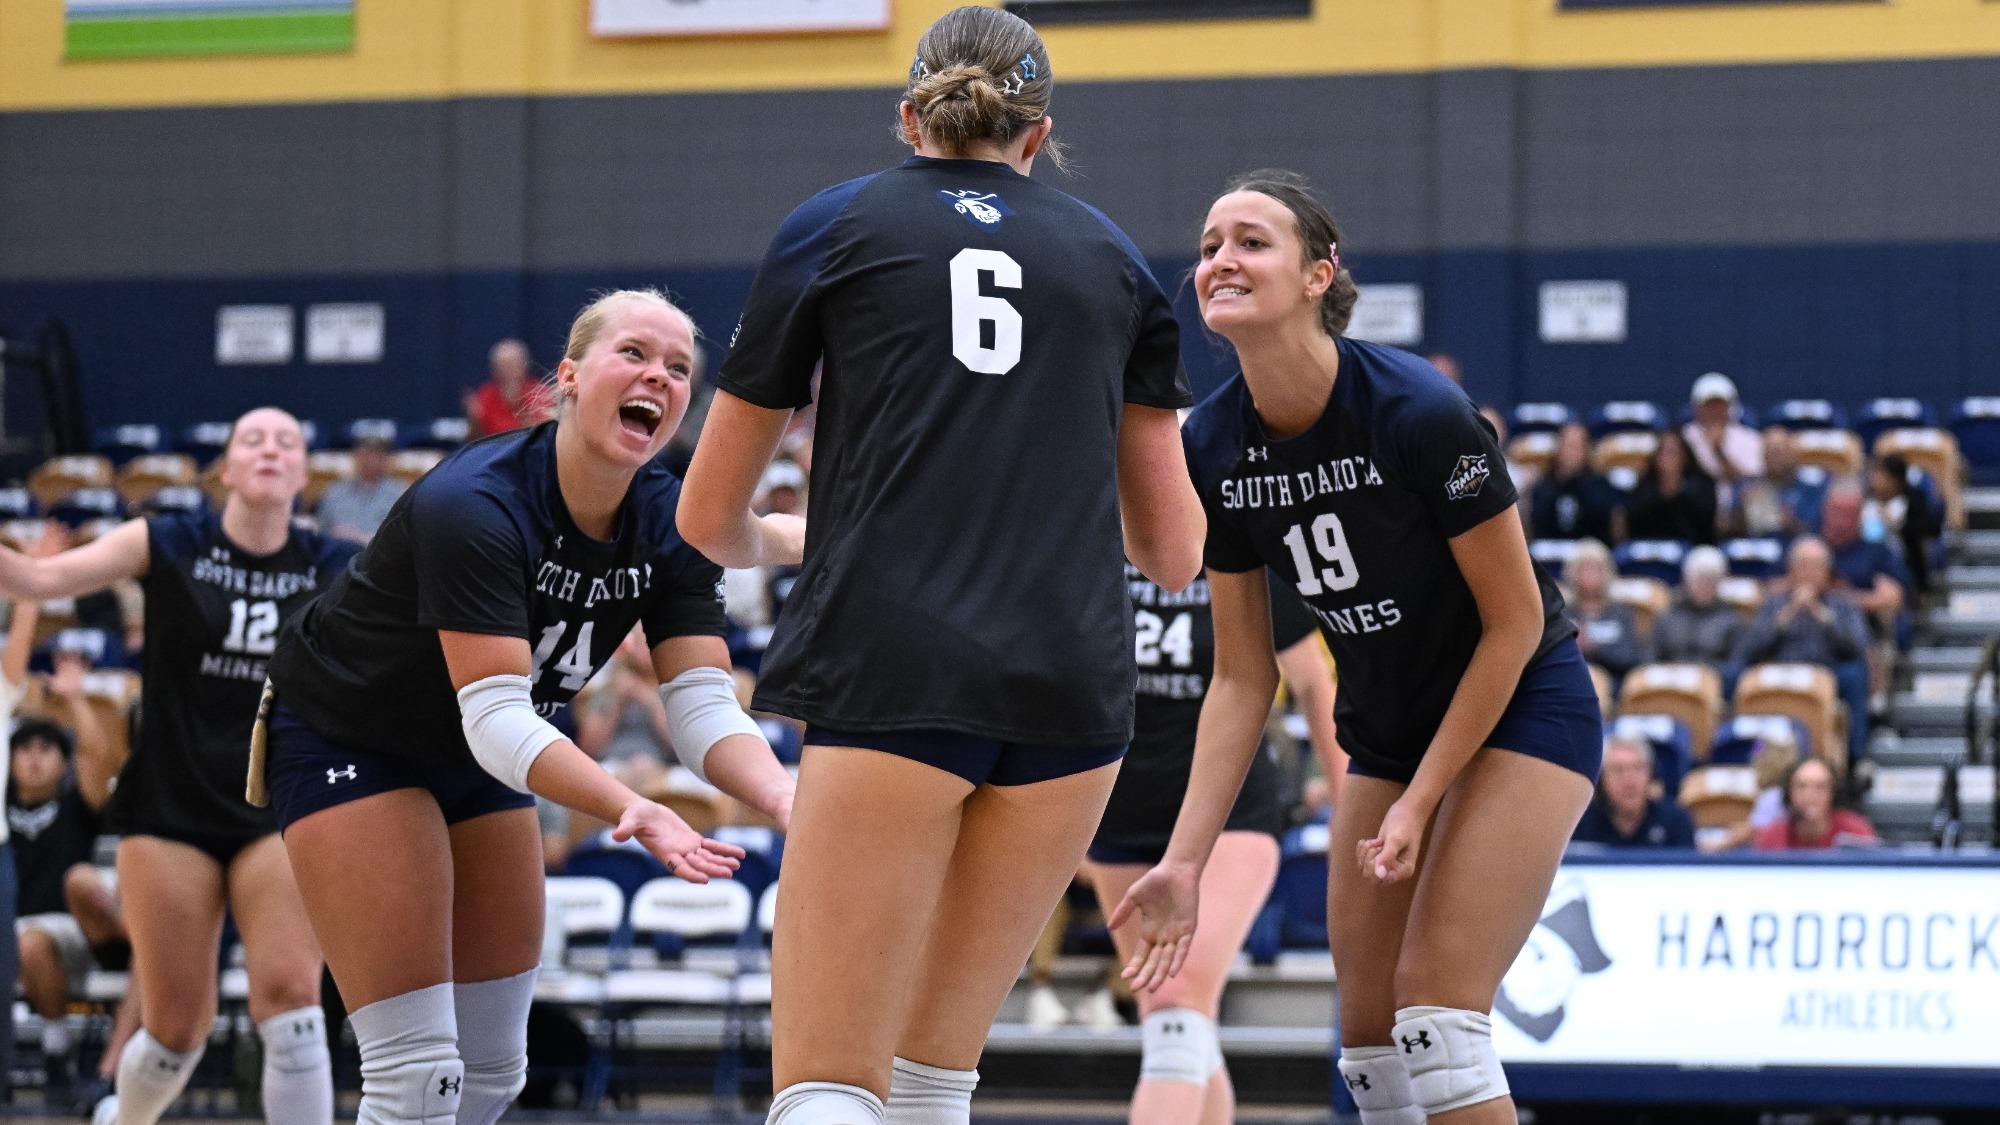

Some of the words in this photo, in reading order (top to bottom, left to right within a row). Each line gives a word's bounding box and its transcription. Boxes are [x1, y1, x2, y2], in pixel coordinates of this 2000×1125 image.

[949, 247, 1023, 376] 6
[1221, 474, 1294, 509] SOUTH
[1449, 458, 1489, 495] RMAC
[1282, 512, 1360, 596] 19
[222, 598, 279, 655] 12
[1134, 609, 1194, 668] 24
[1304, 599, 1402, 634] INES
[201, 652, 268, 682] MINE
[531, 620, 595, 691] 14
[1137, 673, 1204, 699] INES
[1656, 912, 2000, 970] HARDROCK
[1781, 990, 1954, 1031] ATHLETICS
